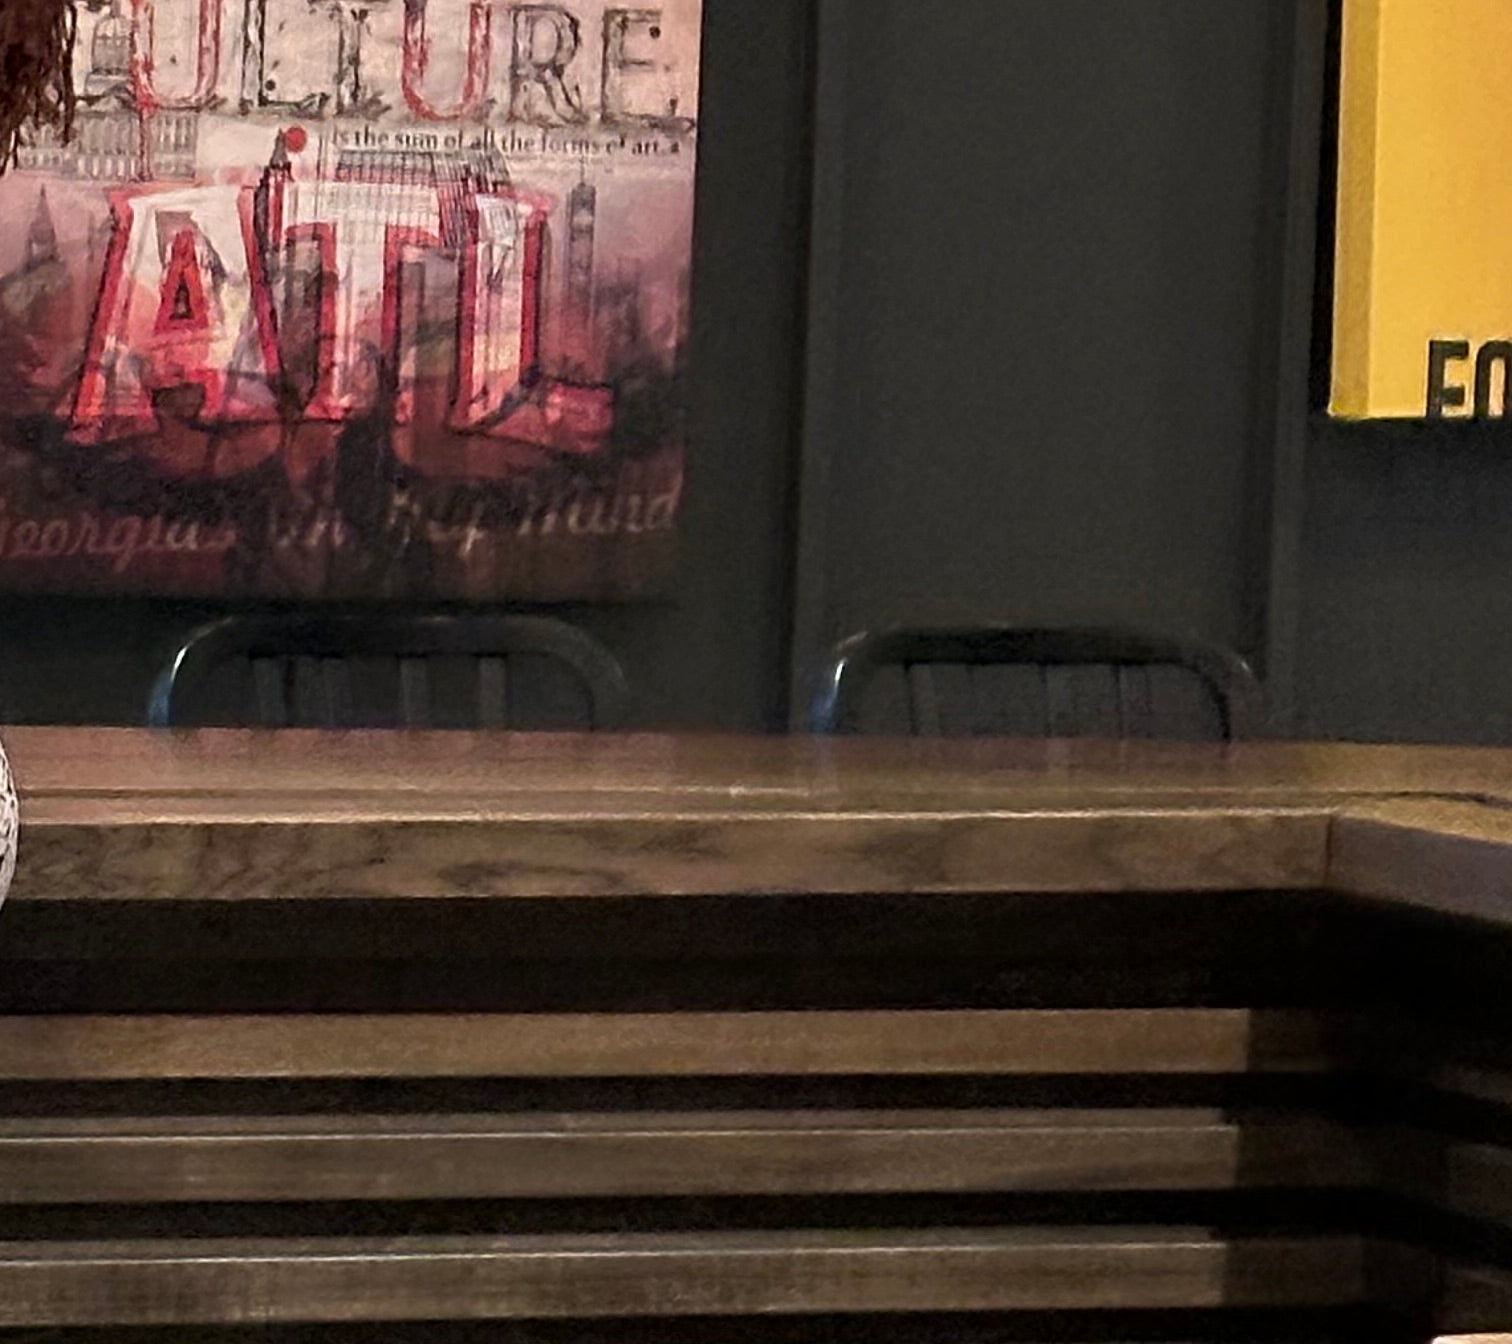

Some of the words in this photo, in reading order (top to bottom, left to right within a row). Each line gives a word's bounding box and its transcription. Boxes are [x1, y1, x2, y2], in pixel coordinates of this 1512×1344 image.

[355, 124, 389, 147] the
[395, 132, 438, 149] sum
[445, 128, 463, 149] of
[502, 129, 535, 152] the
[542, 129, 600, 155] forms
